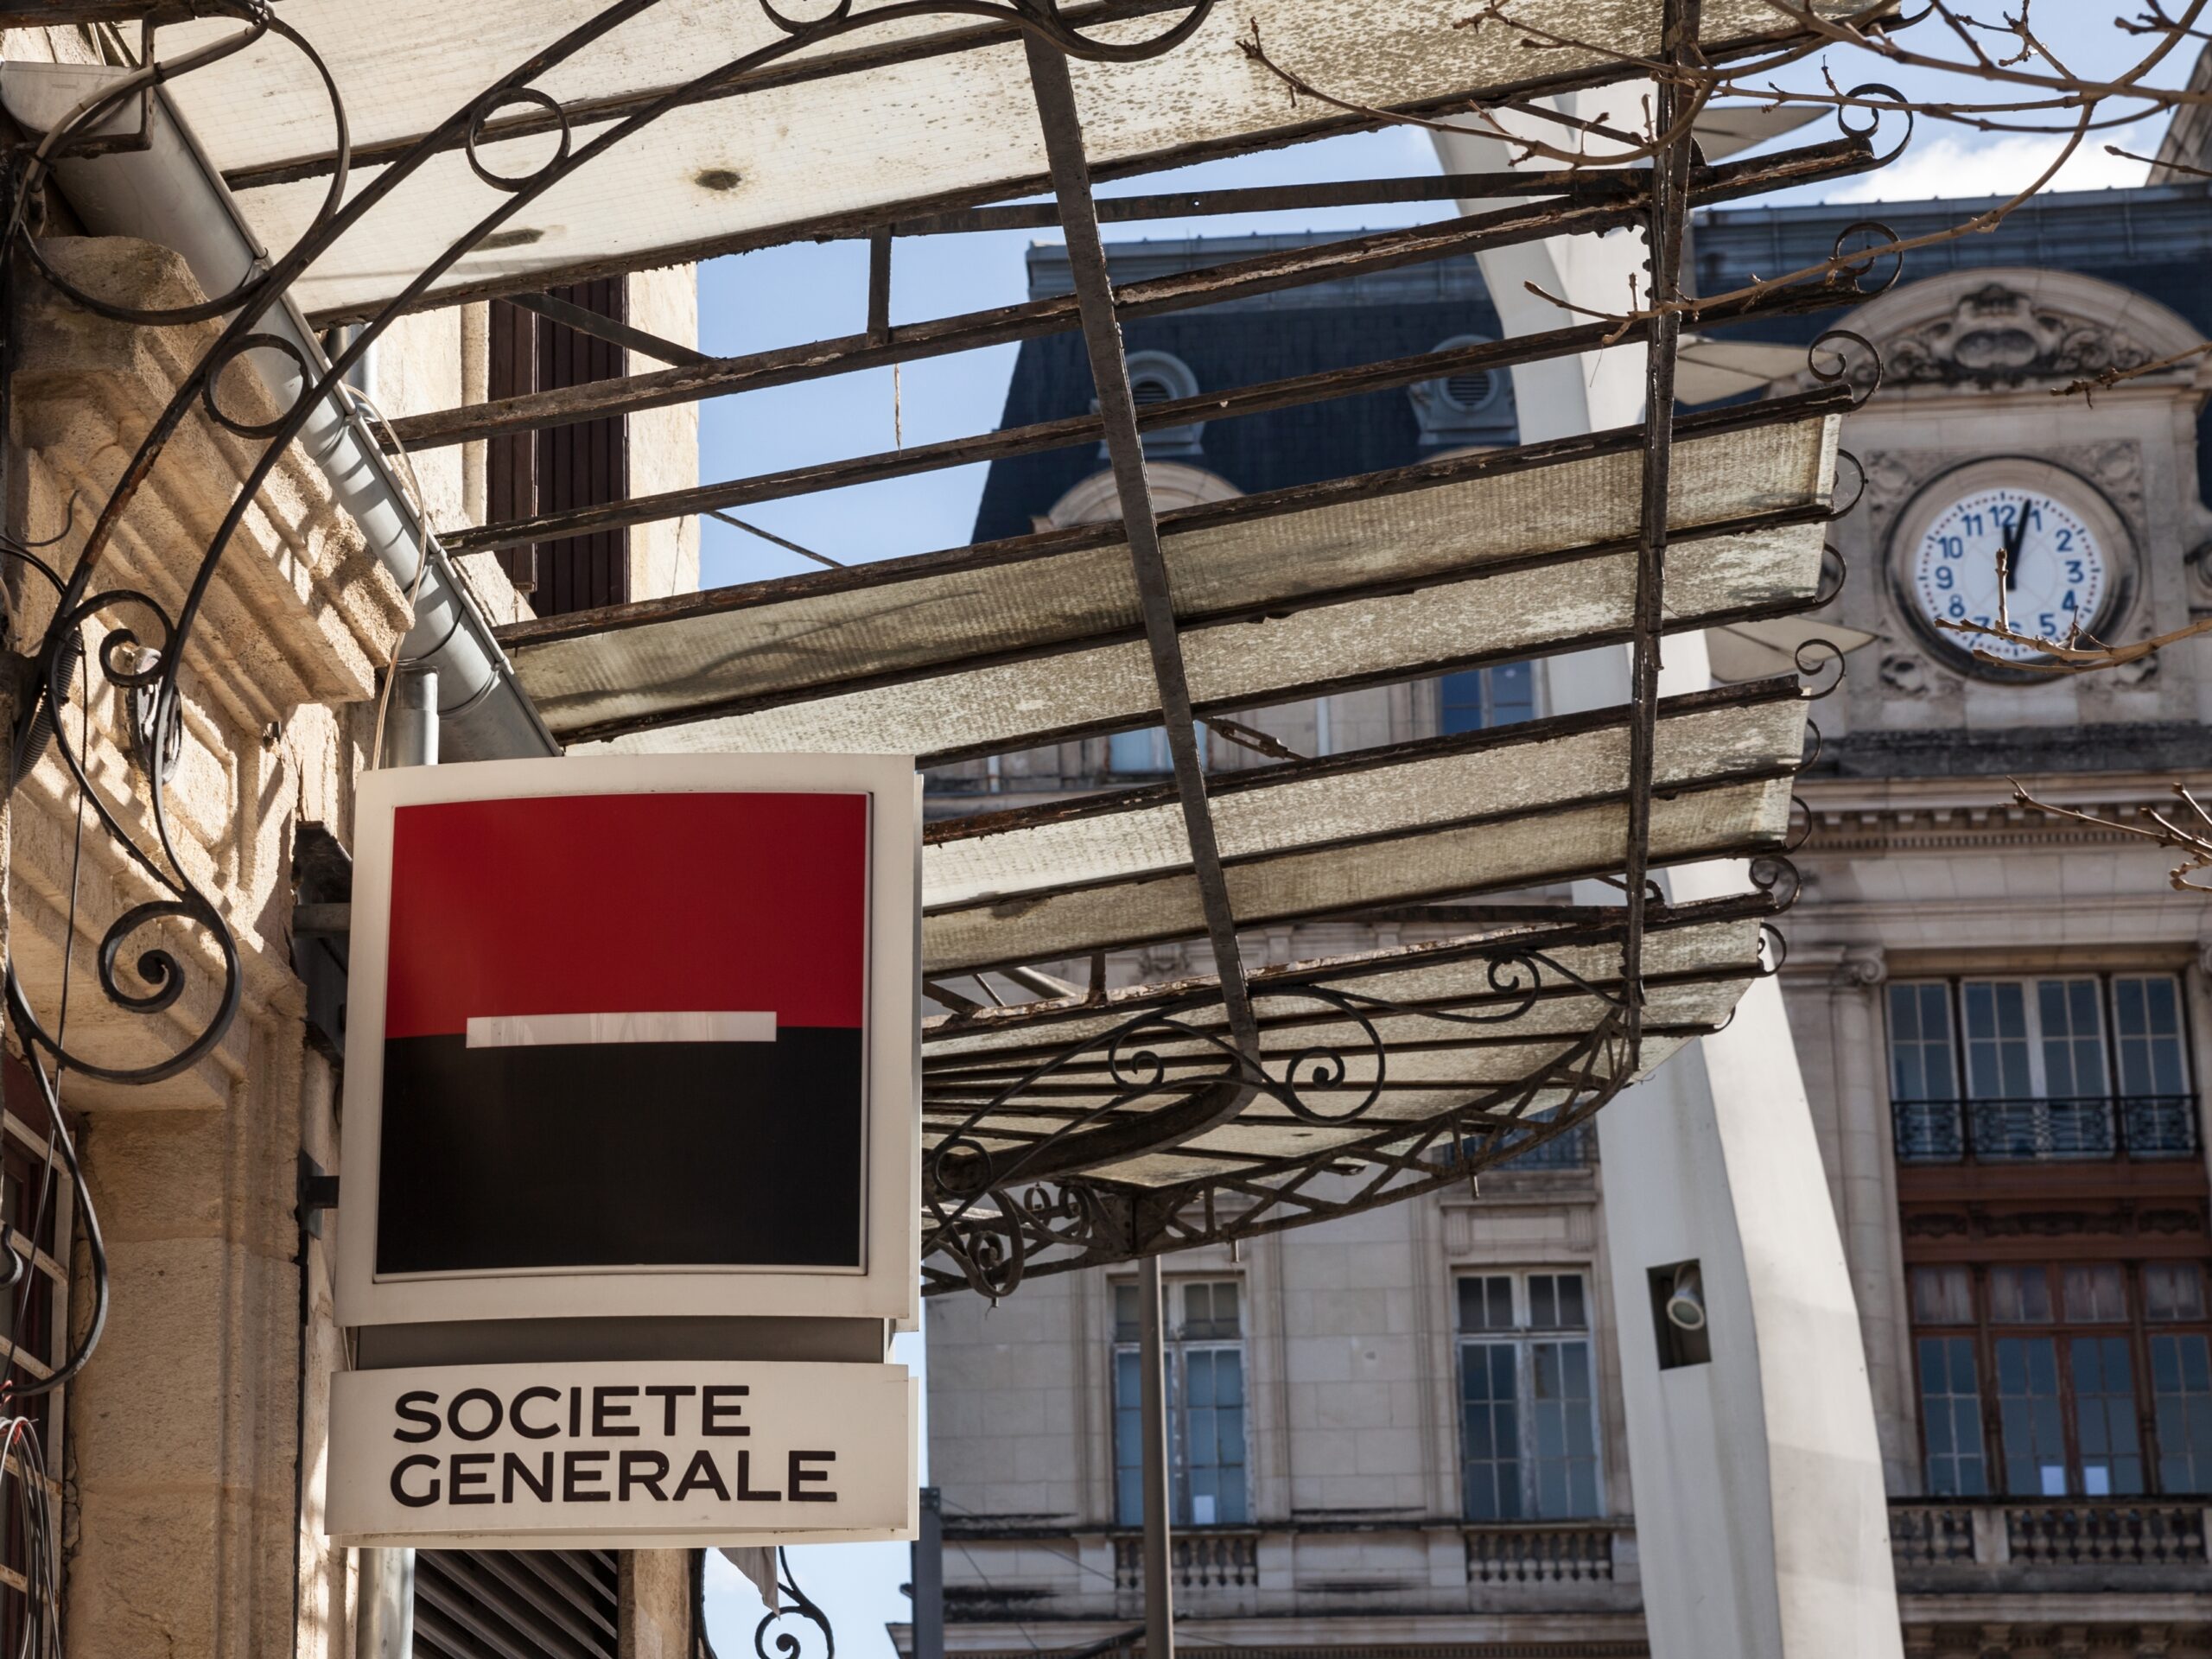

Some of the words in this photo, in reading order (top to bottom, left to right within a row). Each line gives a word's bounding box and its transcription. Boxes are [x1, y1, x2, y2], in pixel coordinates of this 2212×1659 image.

[1961, 514, 1983, 536] 11
[1989, 505, 2016, 527] 12
[1938, 537, 1962, 558] 10
[2056, 529, 2072, 551] 2
[1936, 566, 1953, 589] 9
[2065, 561, 2083, 582] 3
[1948, 594, 1965, 617] 8
[2062, 590, 2077, 611] 4
[2039, 613, 2056, 636] 5
[392, 1385, 751, 1443] SOCIETE
[390, 1449, 838, 1508] GENERALE
